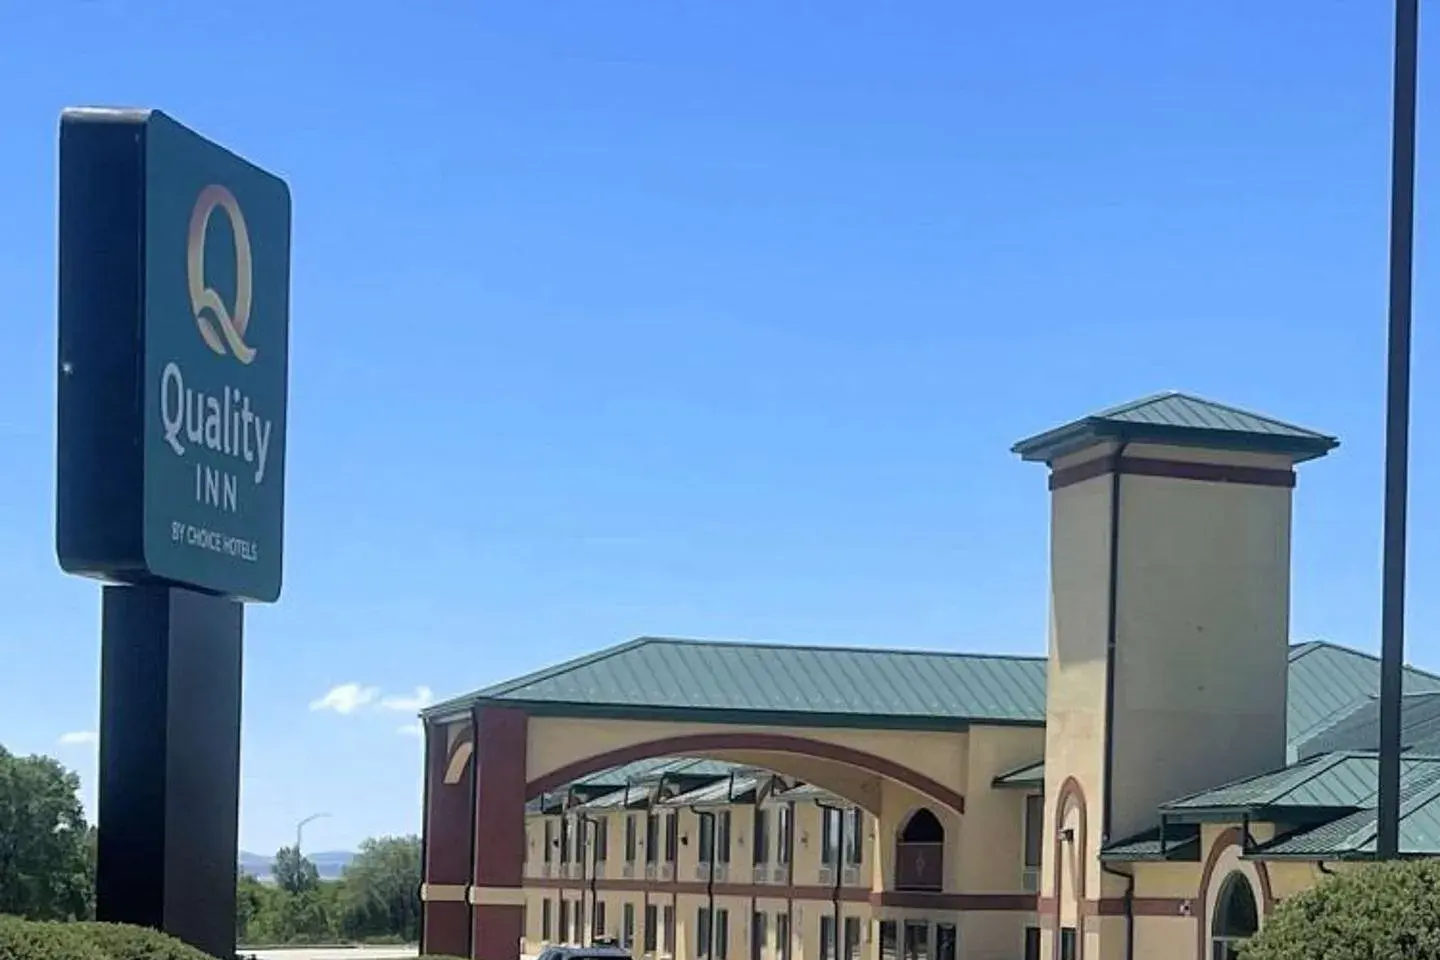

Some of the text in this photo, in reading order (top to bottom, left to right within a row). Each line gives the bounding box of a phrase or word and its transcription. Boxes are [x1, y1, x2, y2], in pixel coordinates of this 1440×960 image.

[188, 184, 257, 365] Q
[161, 362, 271, 484] Quality
[197, 463, 237, 512] INN
[171, 521, 258, 561] BY CHOICE HOTELS
